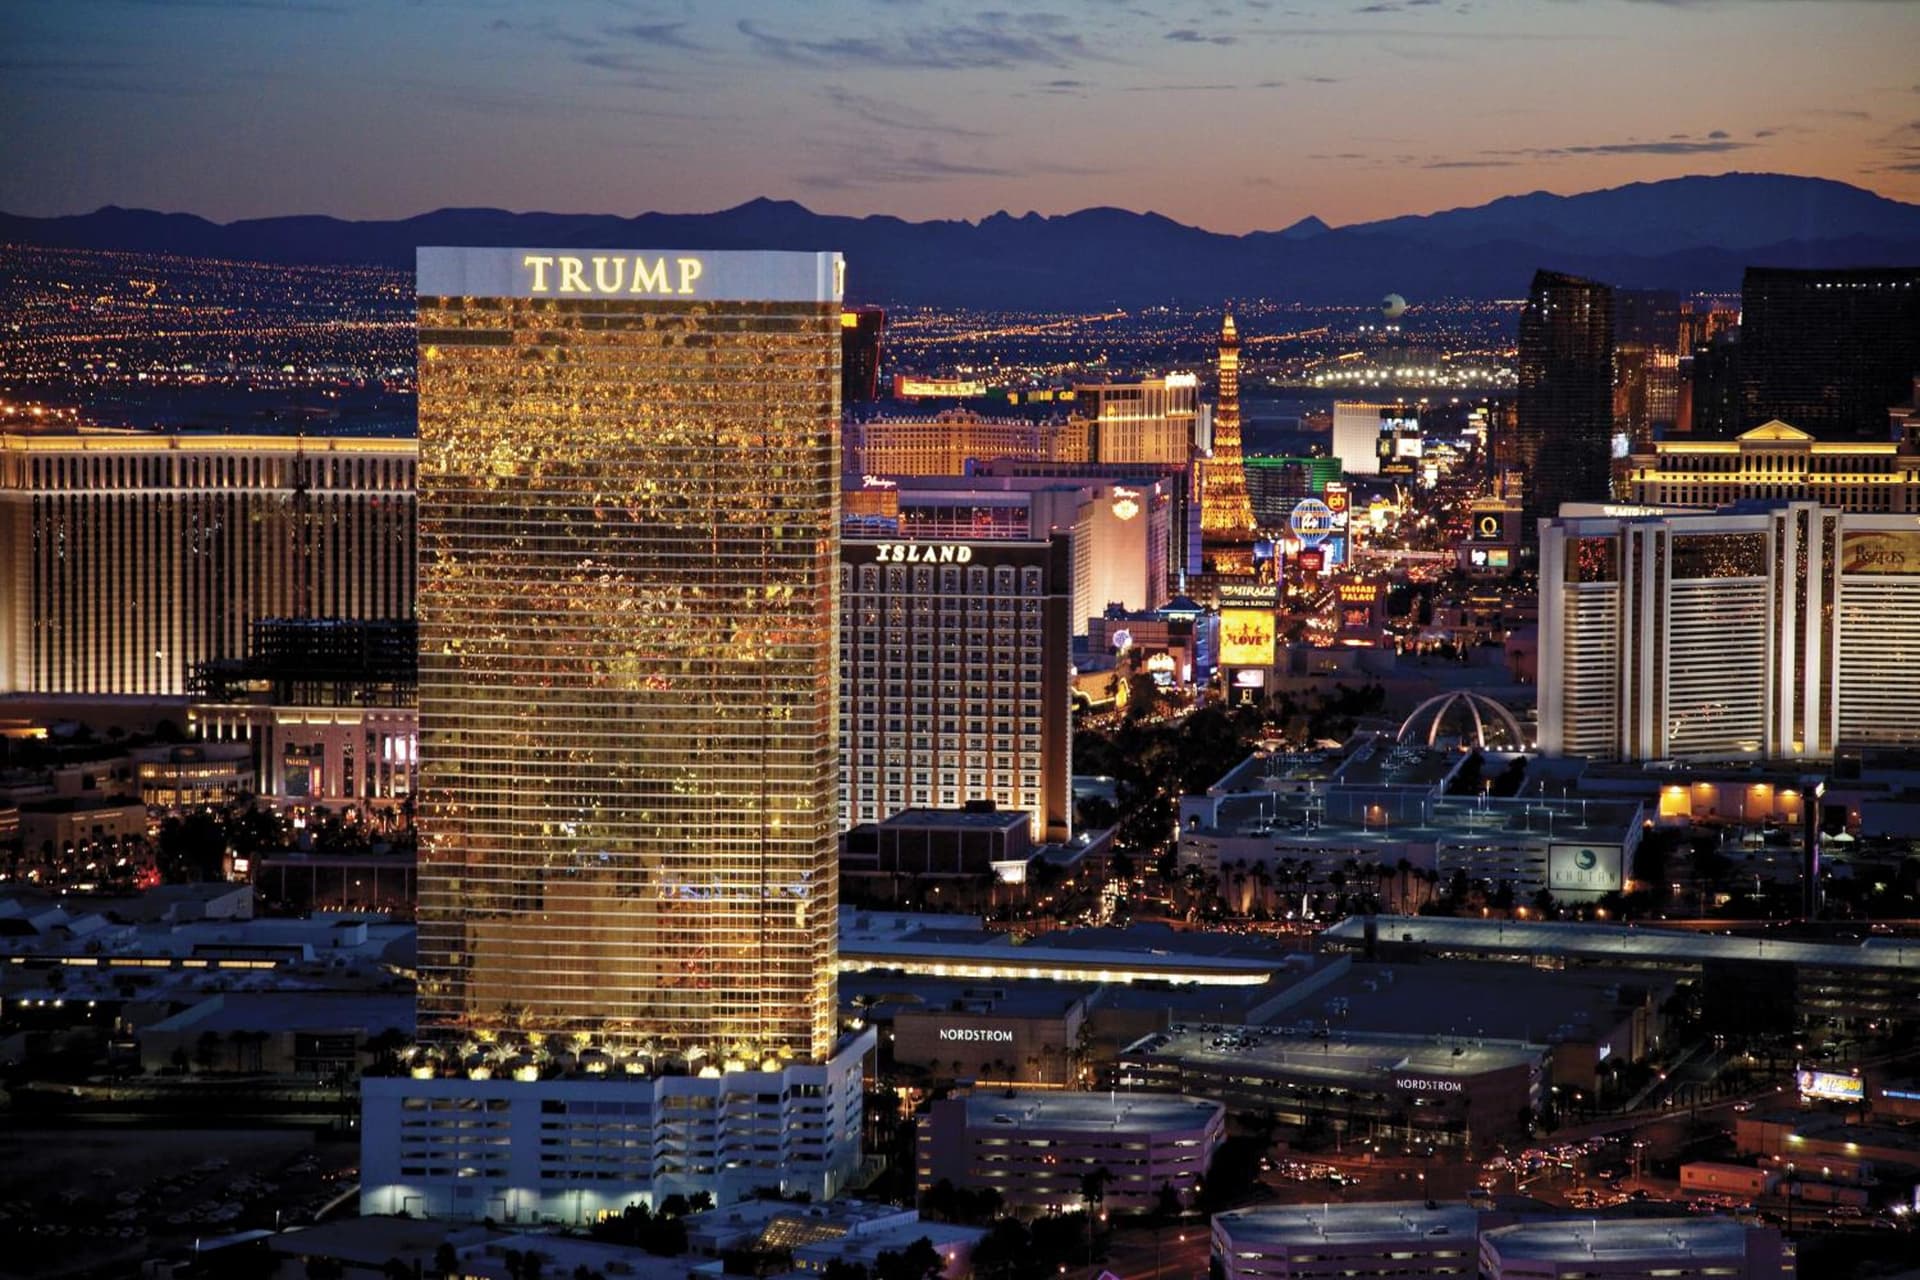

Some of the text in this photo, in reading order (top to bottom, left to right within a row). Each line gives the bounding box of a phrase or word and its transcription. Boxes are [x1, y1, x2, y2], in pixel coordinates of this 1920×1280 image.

[524, 256, 702, 294] TRUMP
[876, 544, 972, 563] ISLAND
[1232, 635, 1262, 646] LOVE
[939, 1029, 1013, 1042] NORDSTROM
[1396, 1079, 1462, 1092] NORDSTROM
